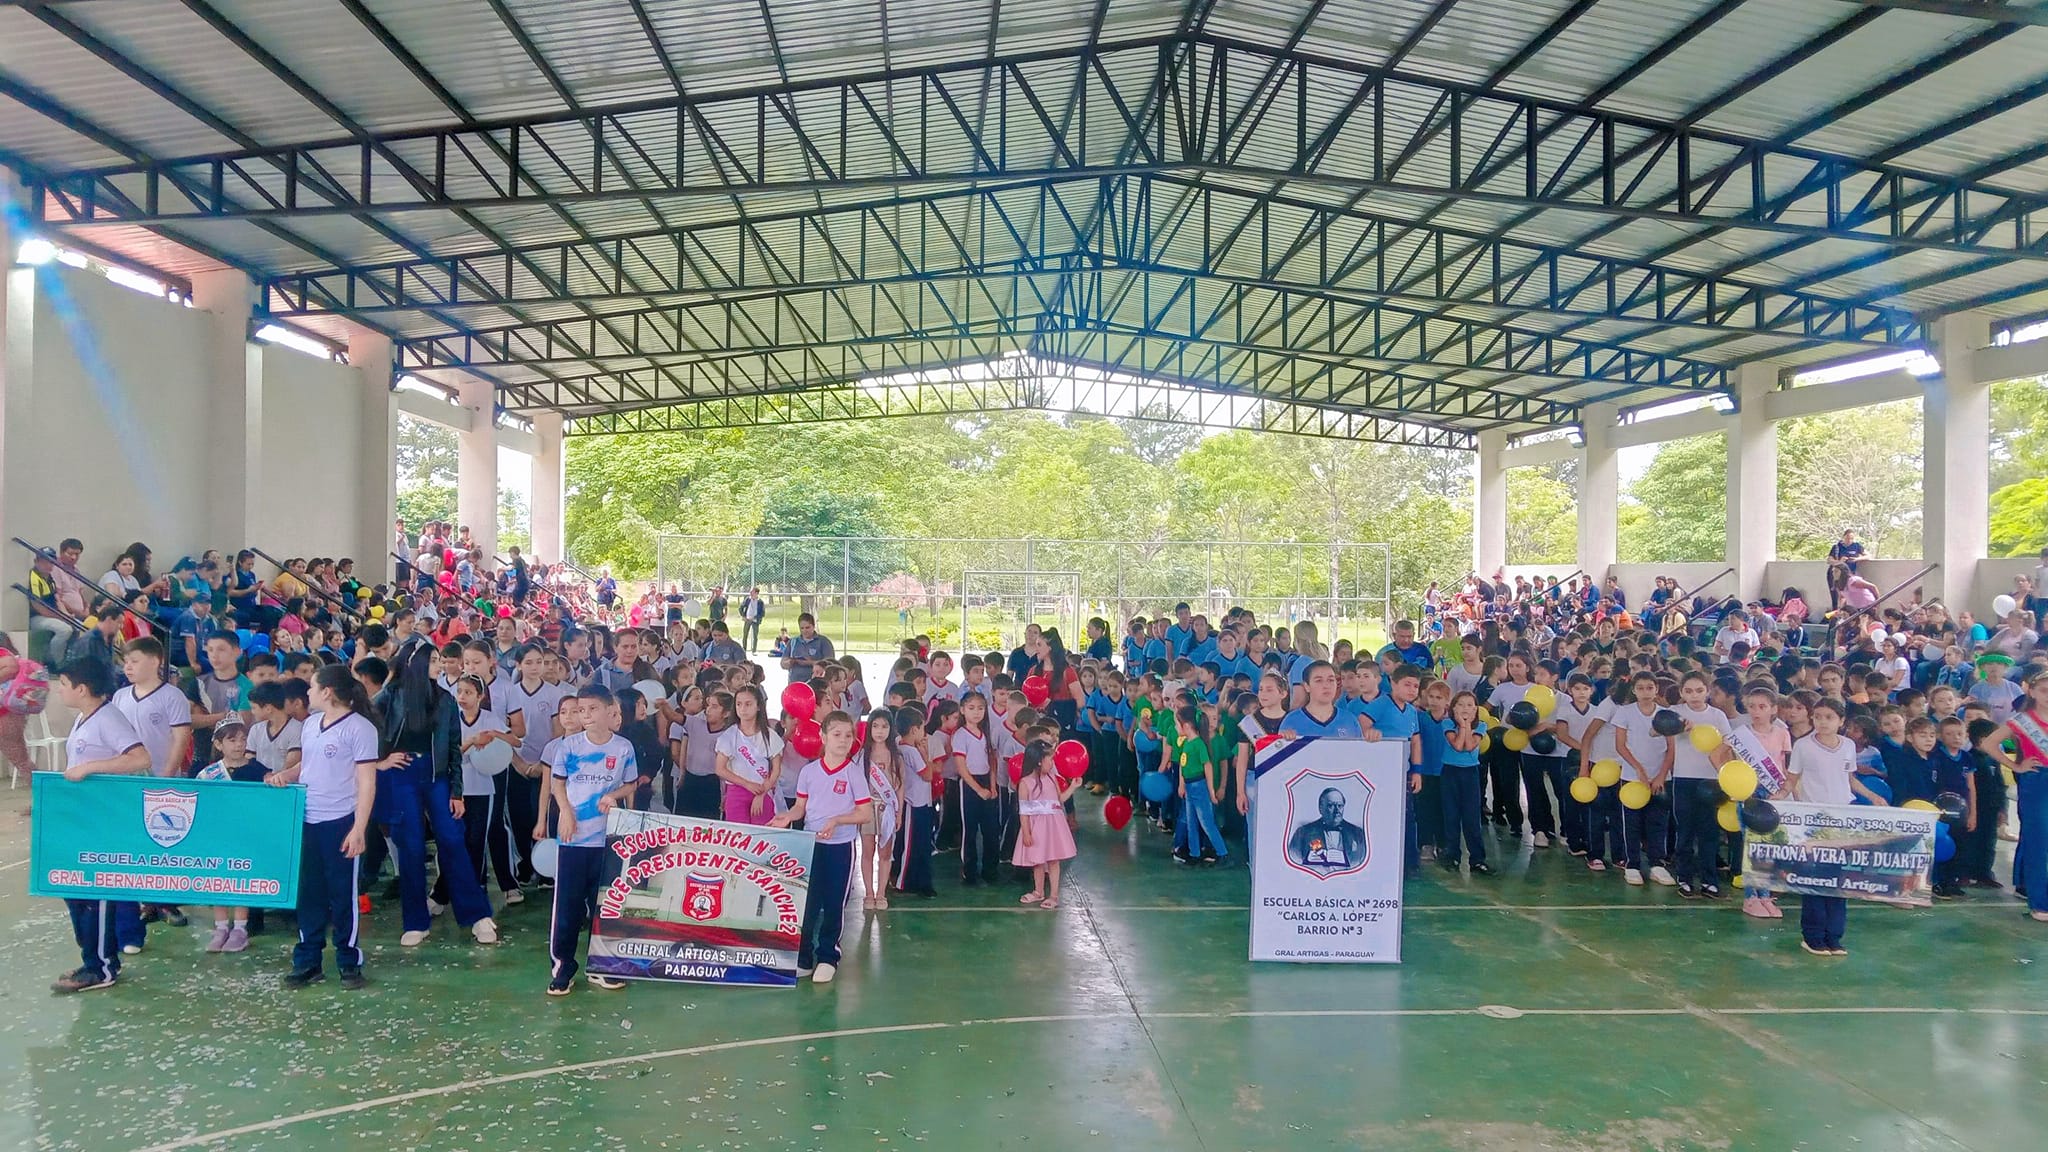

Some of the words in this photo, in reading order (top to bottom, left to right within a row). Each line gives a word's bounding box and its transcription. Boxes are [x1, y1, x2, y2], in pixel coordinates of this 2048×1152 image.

[576, 774, 613, 782] ETIHAD
[1864, 819, 1892, 832] 3864
[611, 826, 687, 860] ESCUELA
[691, 822, 752, 851] BÁSICA
[771, 851, 806, 878] 699
[1748, 843, 1808, 862] PETRONA
[1812, 847, 1847, 865] VERA
[1851, 849, 1870, 866] DE
[79, 852, 147, 865] ESCUELA
[150, 853, 203, 868] BÁSICA
[227, 859, 252, 870] 166
[48, 869, 91, 886] GRAL.
[95, 872, 190, 891] BERNARDINO
[192, 876, 280, 895] CABALLERO
[600, 876, 632, 919] VICE
[626, 851, 750, 883] PRESIDENTE
[1785, 872, 1838, 888] General
[1841, 878, 1889, 893] Artigas
[1263, 897, 1312, 907] ESCUELA
[1315, 896, 1355, 908] BÁSICA
[1372, 899, 1399, 909] 2698
[1329, 912, 1339, 922] A.
[1297, 925, 1339, 935] BARRIO
[1356, 926, 1363, 936] 3
[618, 942, 671, 958] GENERAL
[676, 947, 727, 962] ARTIGAS
[735, 951, 776, 967] ITAPÚA
[1274, 949, 1294, 957] GRAL
[664, 963, 728, 979] PARAGUAY
